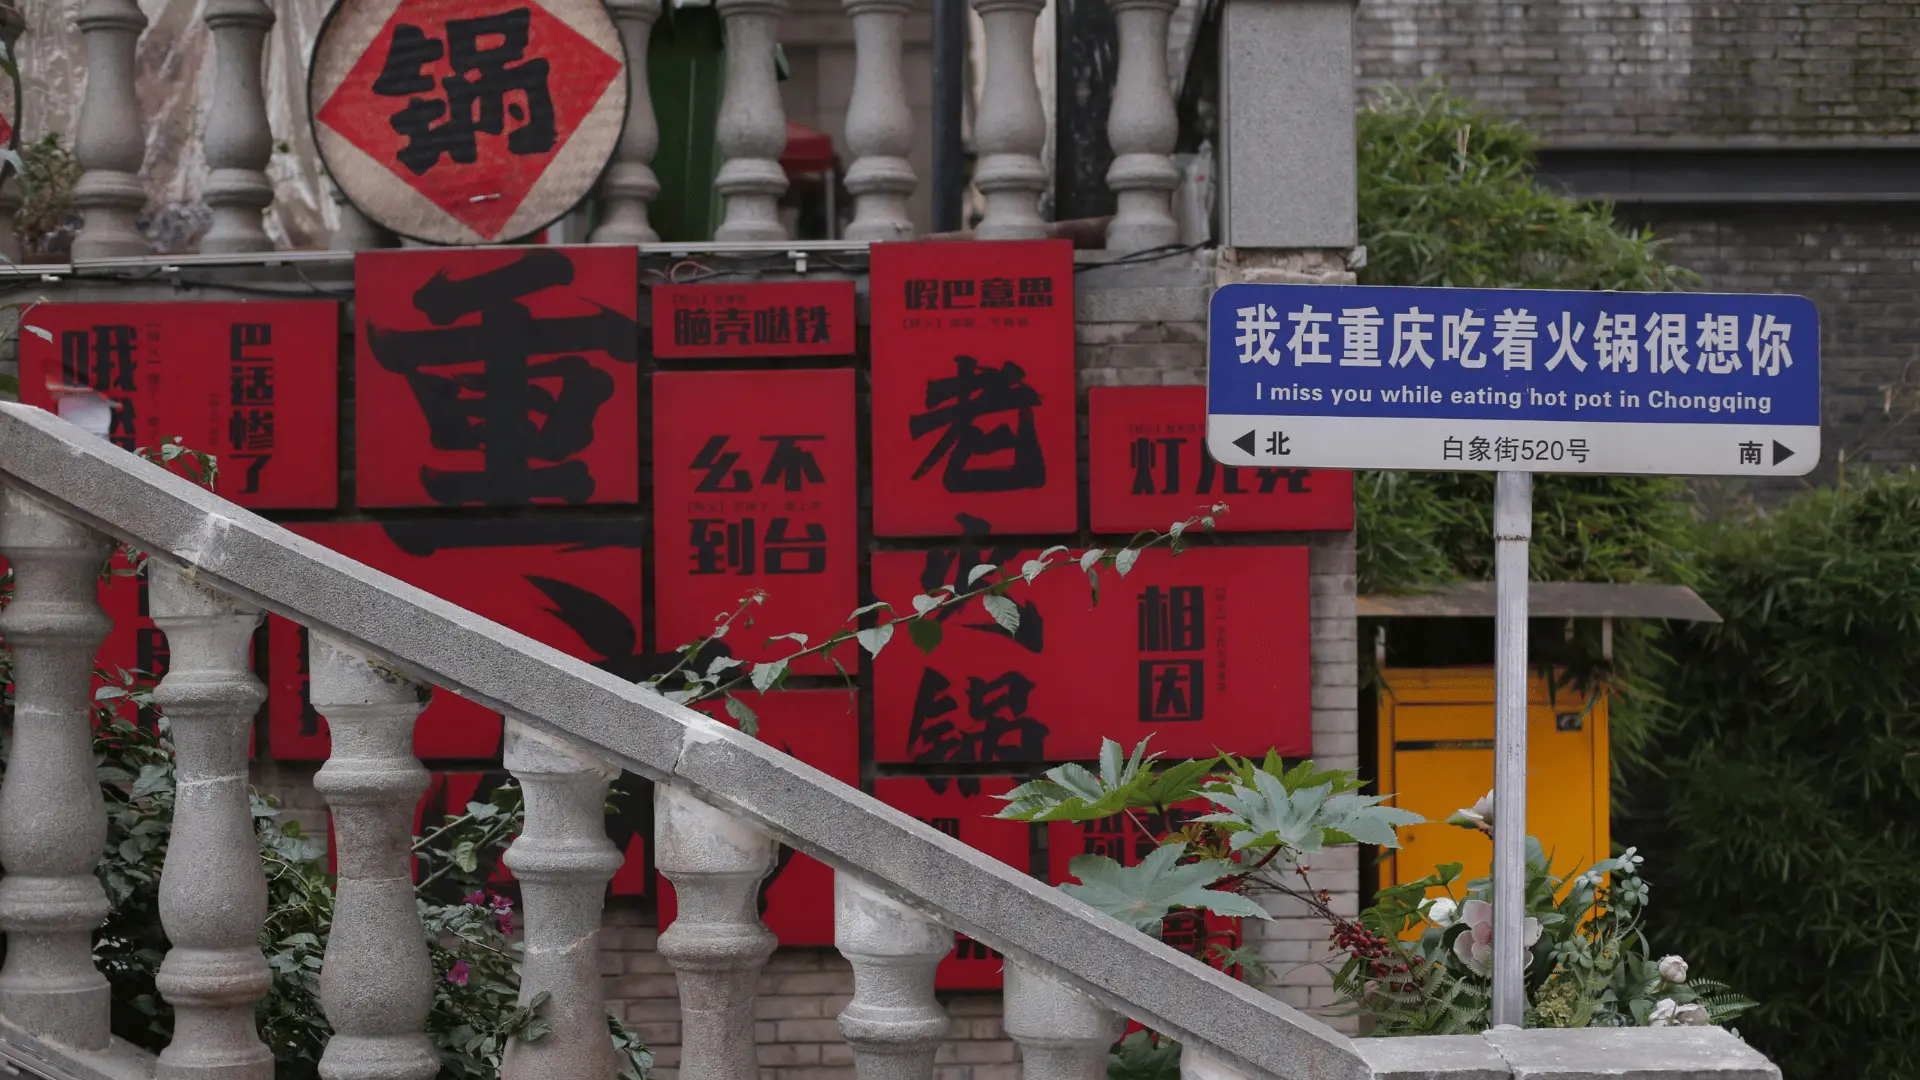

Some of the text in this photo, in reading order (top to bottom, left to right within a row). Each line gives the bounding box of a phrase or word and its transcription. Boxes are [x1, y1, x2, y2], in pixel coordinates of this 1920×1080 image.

[372, 7, 558, 176] 锅
[904, 277, 1053, 310] 假巴意思
[674, 306, 832, 346] 脑壳哒铁
[1235, 304, 1794, 377] 我在重庆吃着火锅很想你
[228, 323, 274, 494] 巴适惨了
[1256, 382, 1771, 414] I miss you while eating hot pot in Chongqing
[1265, 431, 1291, 456] 北
[1443, 436, 1590, 464] 白象街520号
[1738, 440, 1763, 465] 南
[688, 518, 827, 575] 到台
[1137, 586, 1204, 722] 相因
